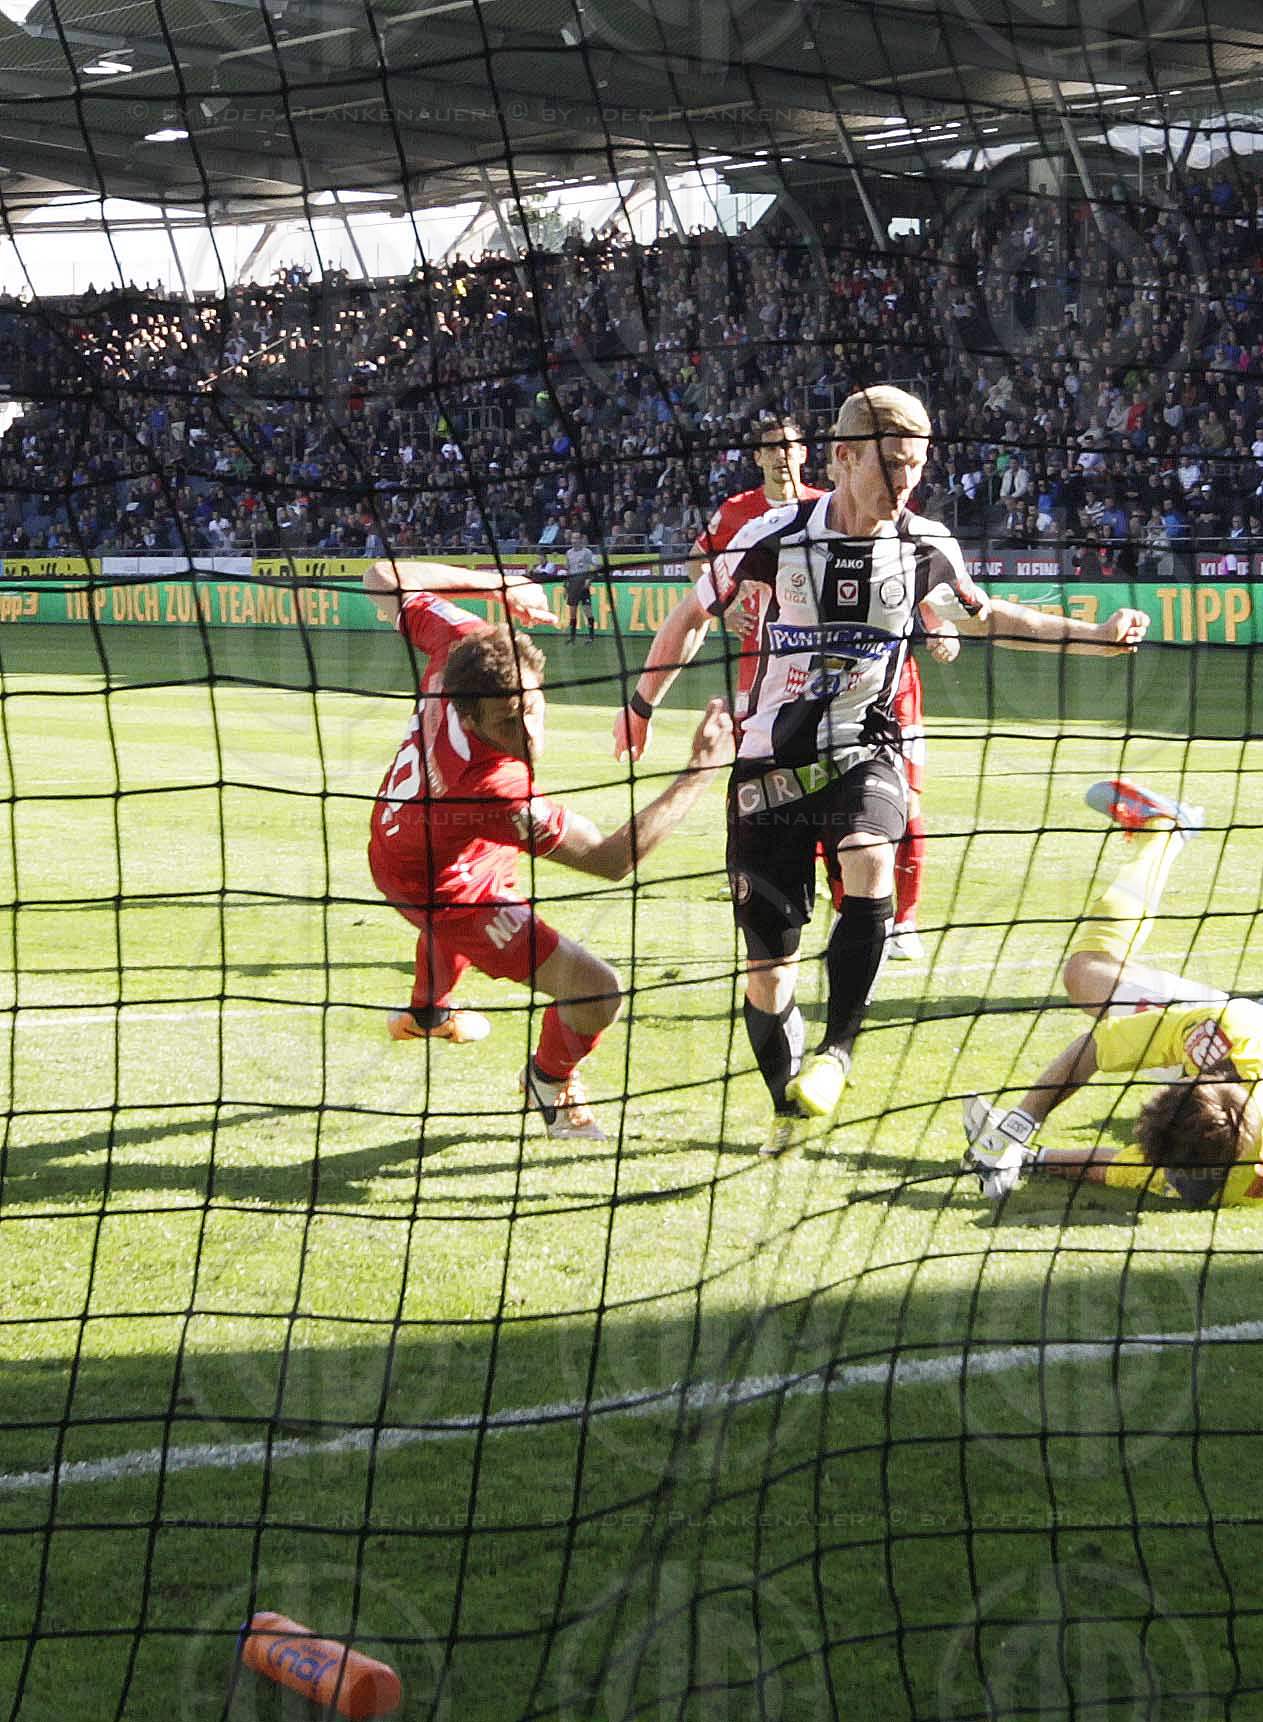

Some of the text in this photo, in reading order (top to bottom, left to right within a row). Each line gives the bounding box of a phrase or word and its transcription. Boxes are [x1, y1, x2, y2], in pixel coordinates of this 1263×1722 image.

[834, 558, 865, 570] JAKO
[112, 585, 159, 622] DICH
[1157, 587, 1252, 643] TIPP
